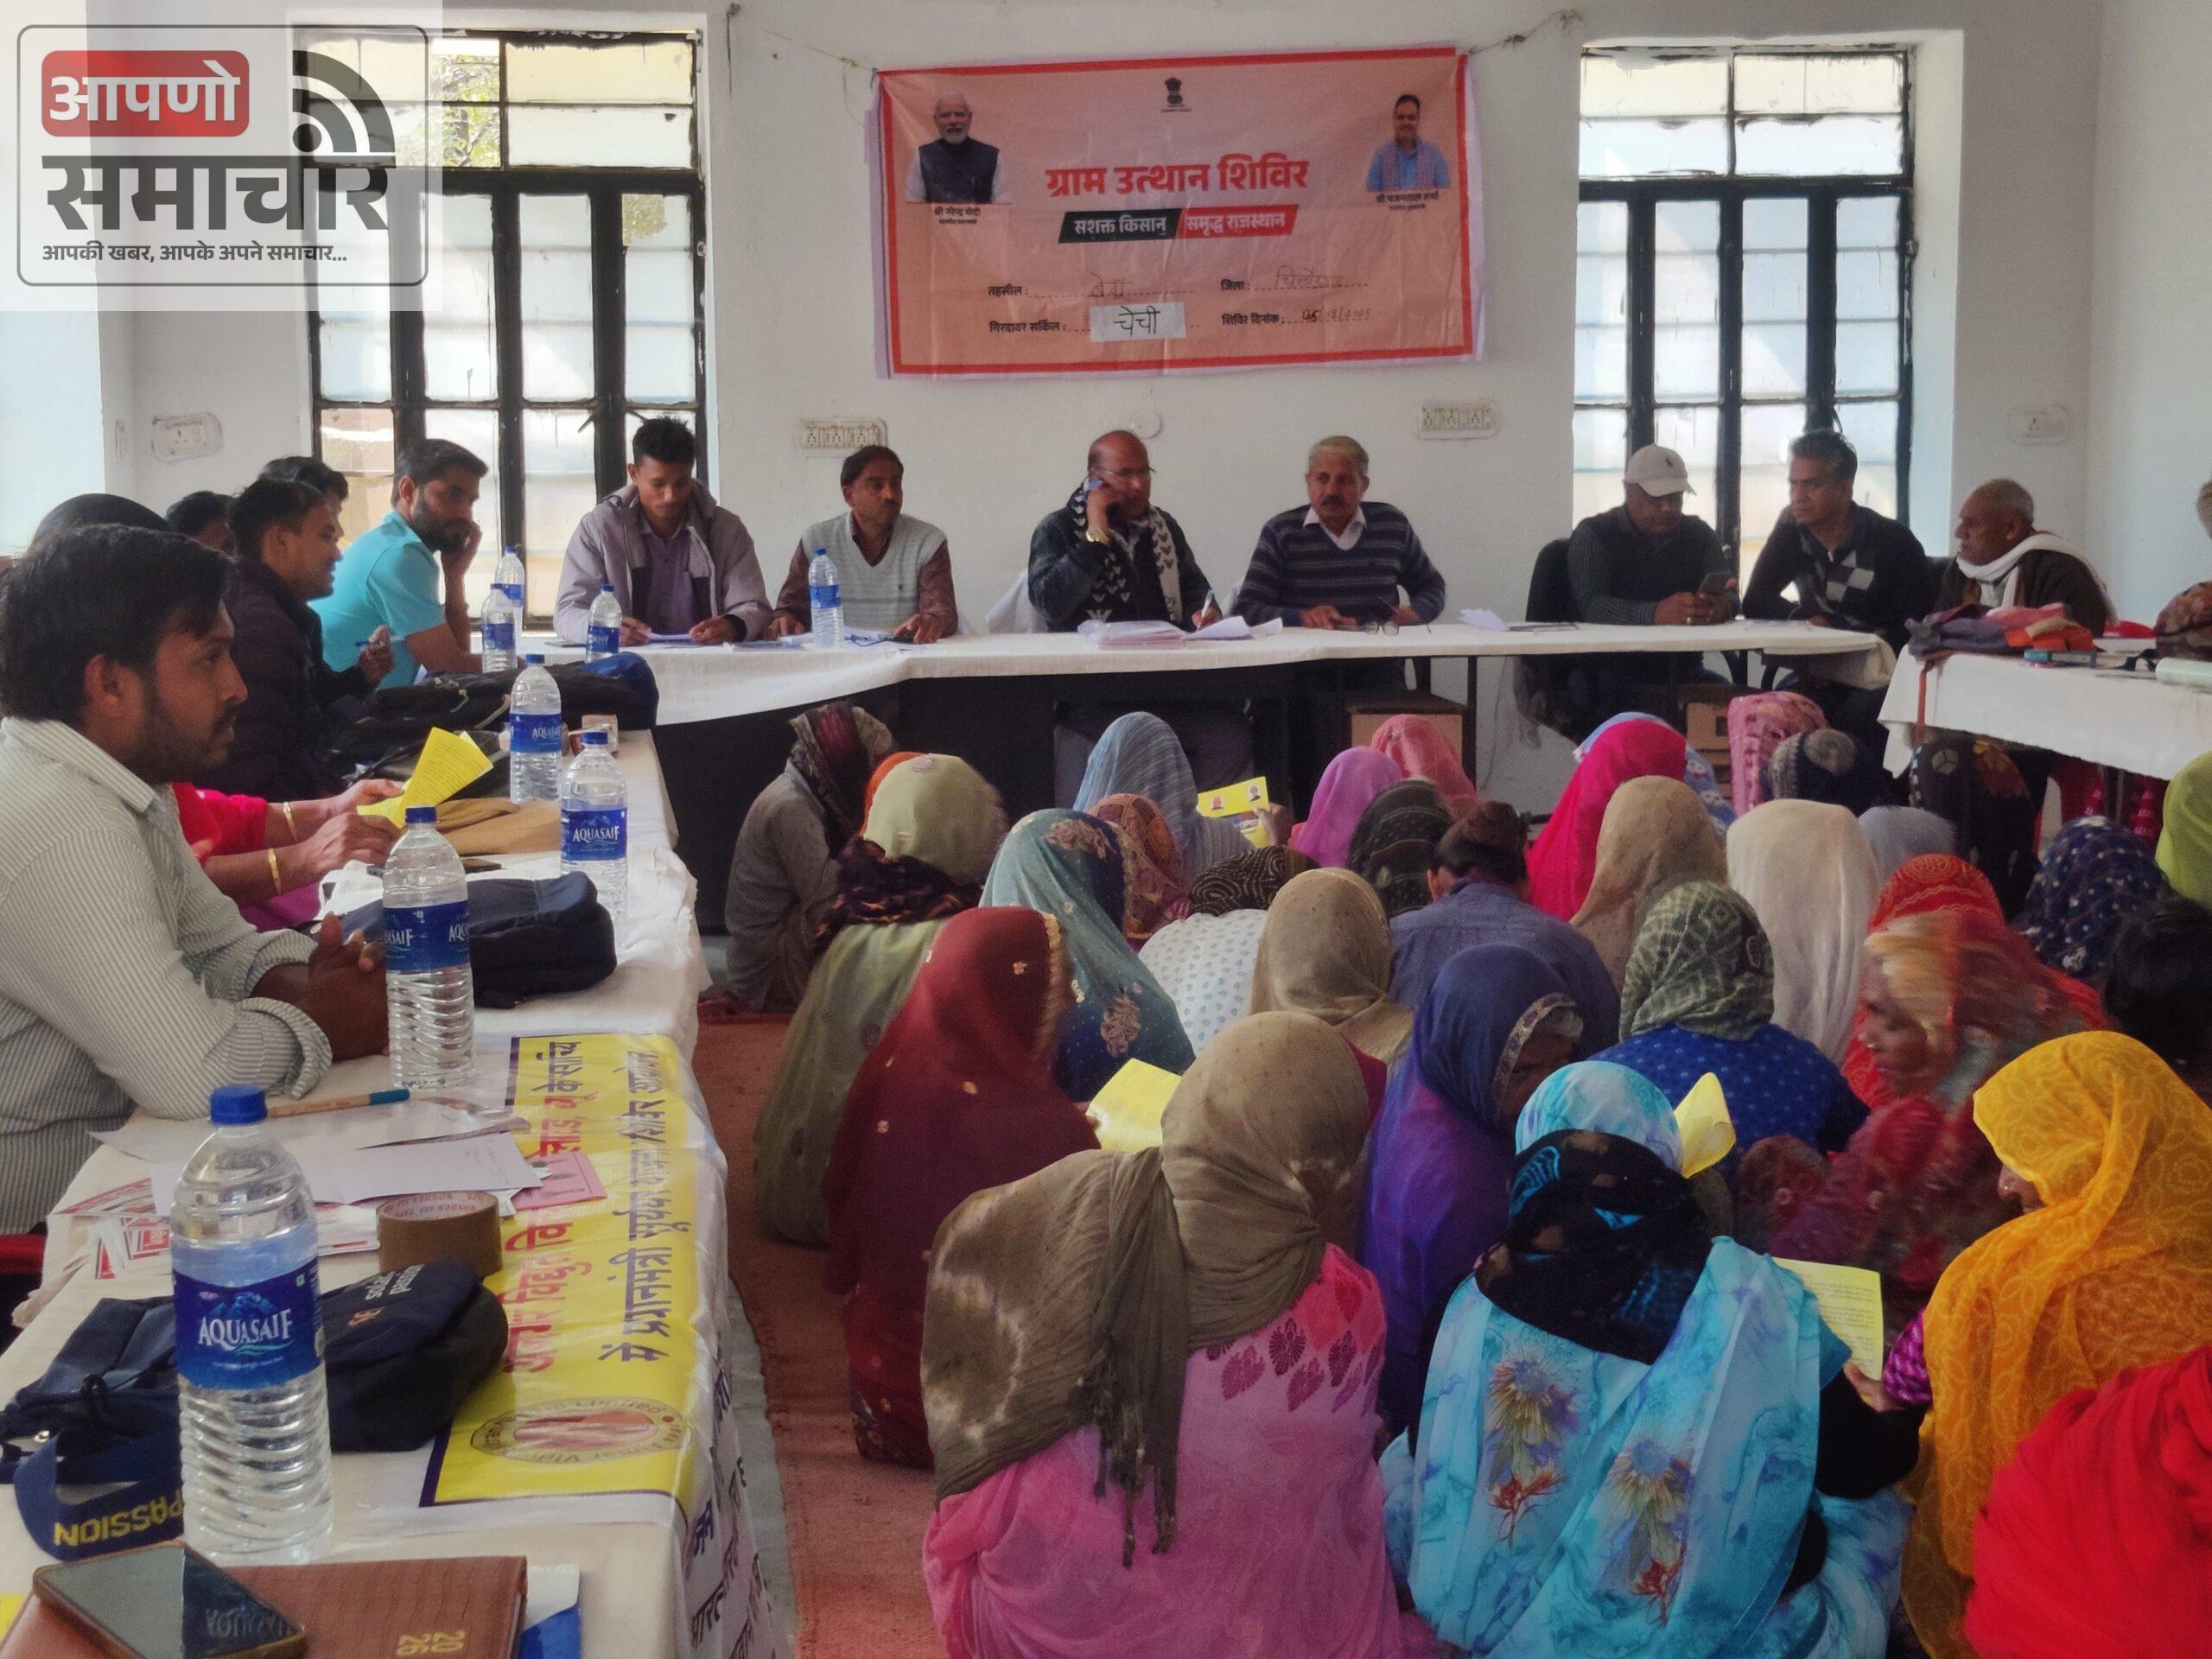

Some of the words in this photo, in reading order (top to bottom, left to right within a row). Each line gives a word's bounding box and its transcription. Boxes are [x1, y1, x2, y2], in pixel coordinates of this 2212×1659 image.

[1045, 167, 1108, 198] ग्राम
[1114, 163, 1211, 194] उत्थान
[1217, 152, 1310, 191] शिविर
[1074, 218, 1116, 235] सशक्त
[1117, 213, 1166, 233] किसान
[1186, 214, 1224, 236] समृद्ध
[1227, 211, 1286, 232] राजस्थान
[989, 321, 1027, 334] गिरदावर
[1114, 305, 1160, 336] चेची
[1222, 313, 1248, 325] शिविर
[572, 825, 620, 843] AQUASAIF
[198, 1308, 293, 1351] AQUASAIF
[54, 1490, 182, 1547] PASSION
